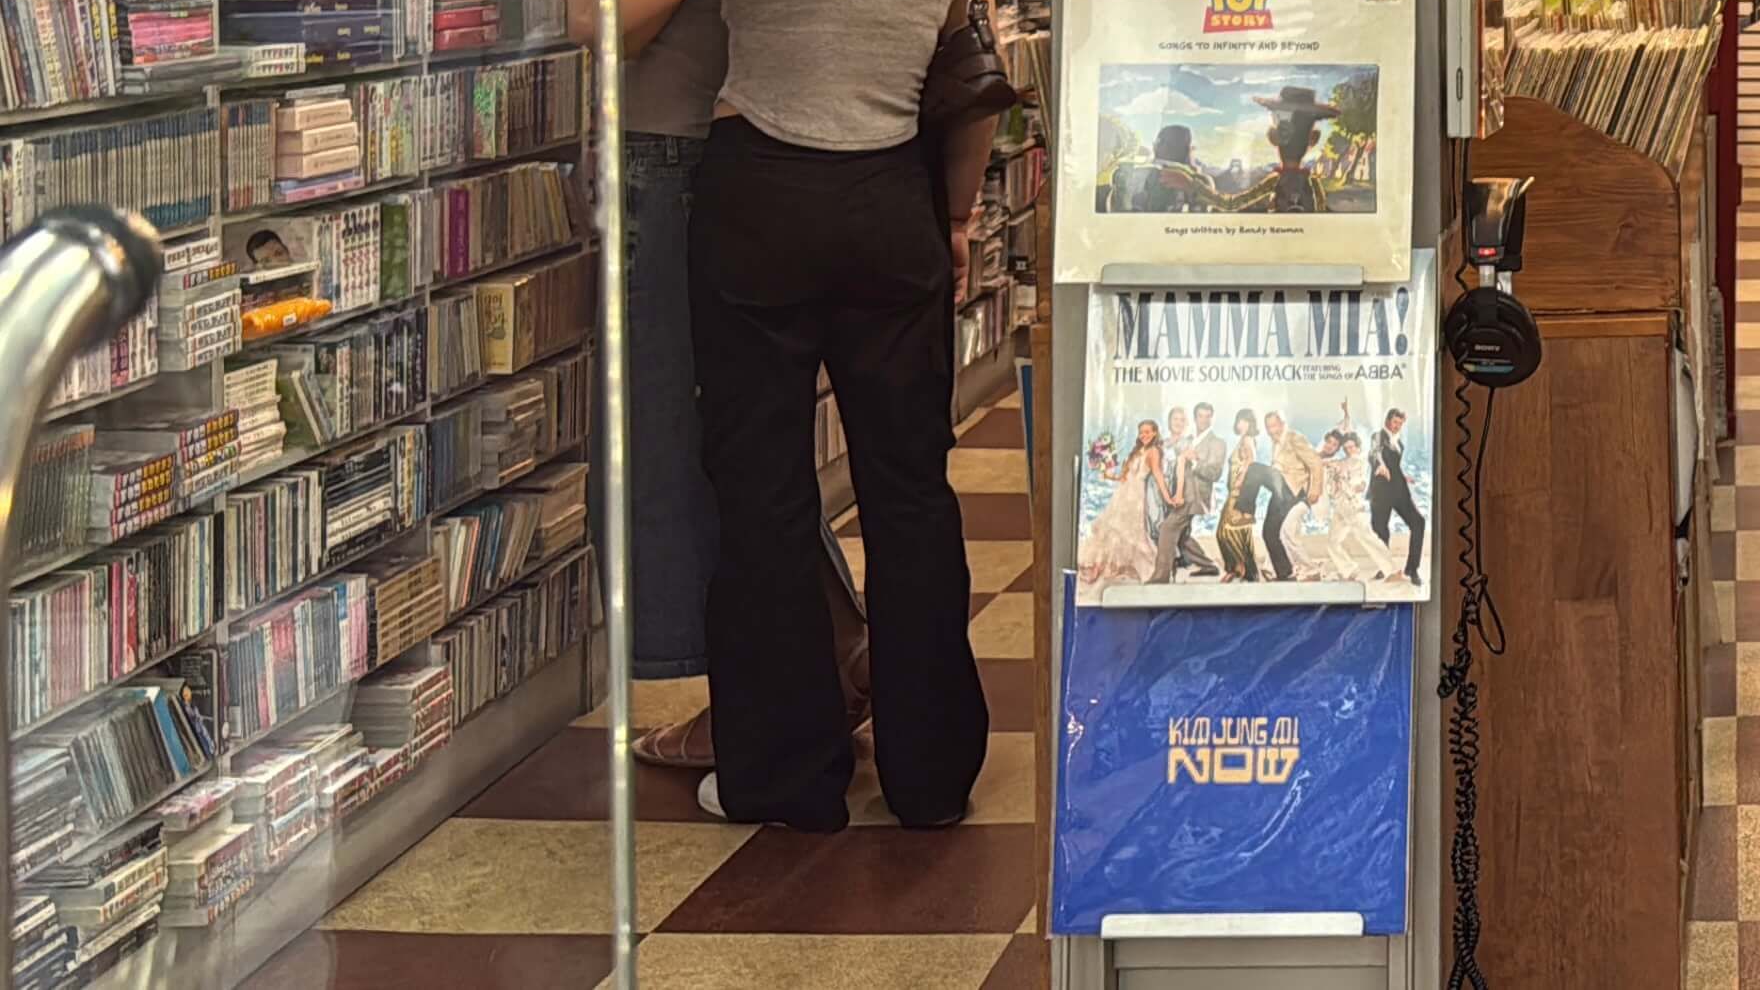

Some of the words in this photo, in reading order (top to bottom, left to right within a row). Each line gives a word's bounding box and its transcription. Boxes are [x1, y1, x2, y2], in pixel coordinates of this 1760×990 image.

[1211, 13, 1268, 27] STORY
[1197, 41, 1210, 51] TO
[1213, 41, 1255, 51] INFINITY
[1258, 41, 1278, 51] AND
[1280, 41, 1320, 51] BEYOND
[1225, 226, 1236, 236] by
[1113, 290, 1294, 360] MAMMA
[1304, 286, 1410, 358] MIA!
[1113, 365, 1142, 383] THE
[1145, 365, 1195, 383] MOVIE
[1199, 364, 1302, 382] SOUNDTRACK
[1212, 716, 1268, 745] JUNG
[1167, 746, 1300, 785] NOW
